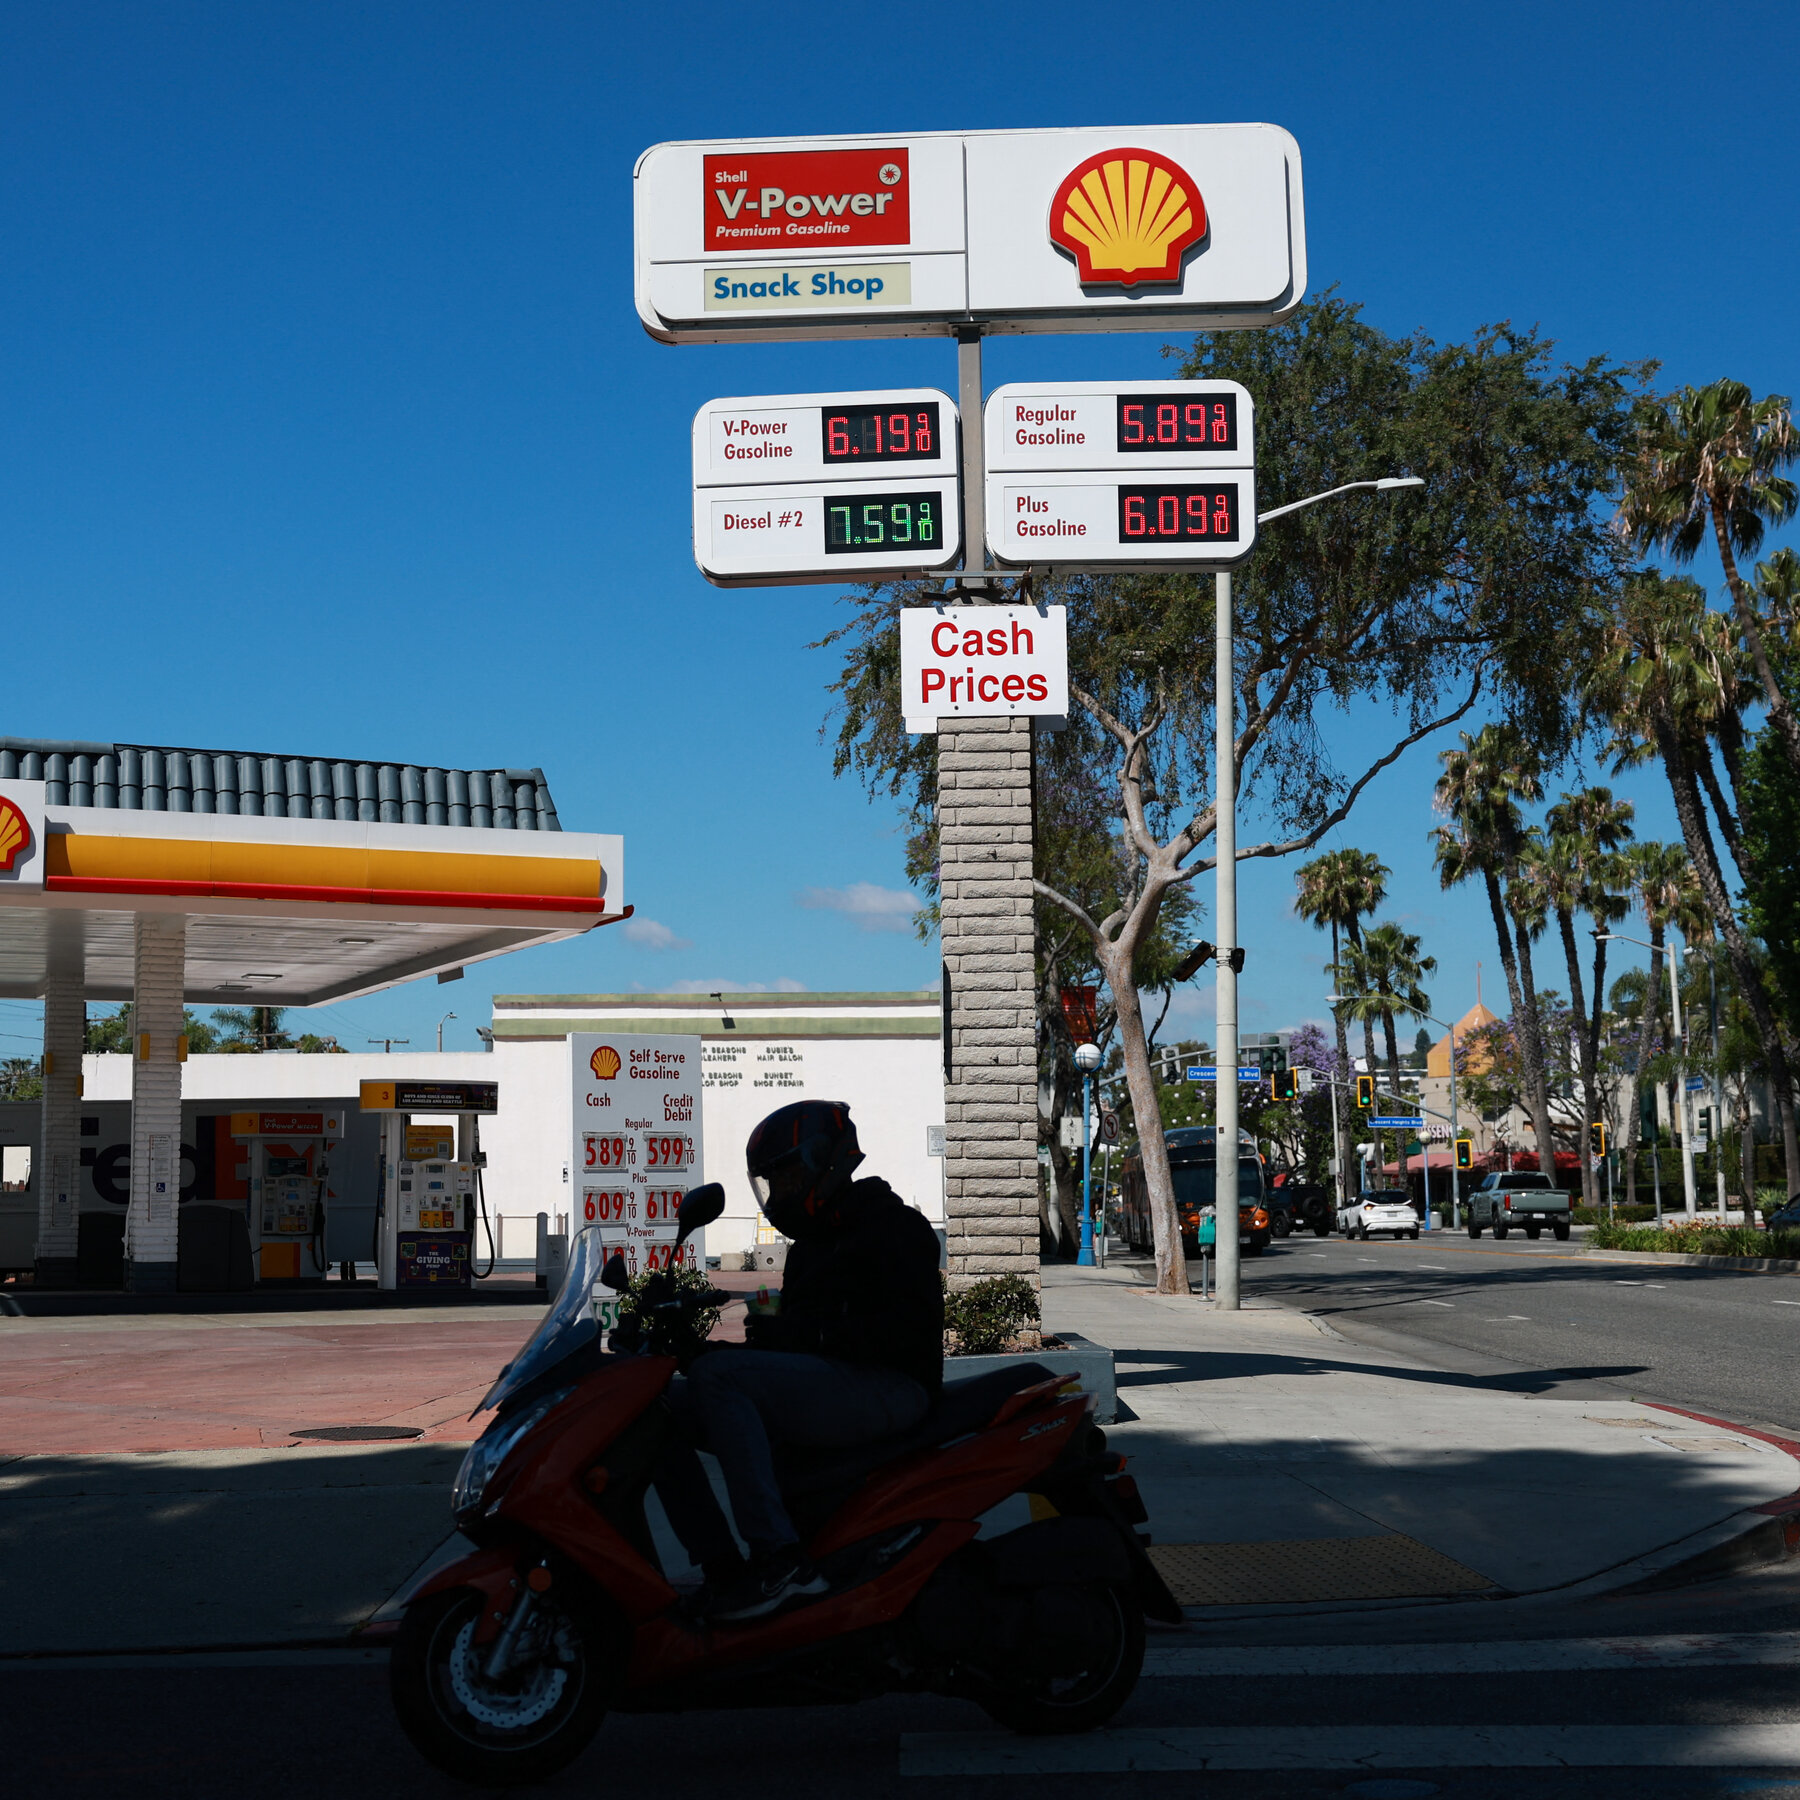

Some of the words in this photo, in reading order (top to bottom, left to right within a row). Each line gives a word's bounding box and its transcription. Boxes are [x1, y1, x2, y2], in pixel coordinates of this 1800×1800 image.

[715, 170, 748, 184] Shell
[715, 185, 893, 219] V-Power
[715, 224, 781, 238] Premium
[785, 220, 851, 236] Gasoline
[714, 272, 800, 300] Snack
[811, 270, 884, 300] Shop
[1016, 405, 1077, 426] Regular
[1123, 403, 1206, 444] 5.89
[723, 419, 788, 437] V-Power
[827, 414, 909, 456] 6.19
[1016, 428, 1086, 445] Gasoline
[724, 442, 792, 460] Gasoline
[1016, 496, 1050, 513] Plus
[723, 512, 772, 531] Diesel
[778, 510, 803, 527] #2
[831, 503, 911, 545] 7.59
[1124, 494, 1207, 536] 6.09
[1016, 520, 1087, 537] Gasoline
[931, 620, 1034, 658] Cash
[921, 666, 1049, 704] Prices
[629, 1049, 651, 1063] Self
[653, 1050, 686, 1064] Serve
[629, 1065, 680, 1080] Gasoline
[1244, 1070, 1259, 1078] Blvd
[777, 1080, 804, 1088] REPAIR
[382, 1091, 389, 1100] 3
[586, 1092, 611, 1107] Cash
[663, 1093, 694, 1108] Credit
[664, 1107, 692, 1122] Debit
[625, 1117, 653, 1131] Regular
[584, 1137, 624, 1166] 589
[647, 1137, 684, 1165] 599
[632, 1173, 648, 1183] Plus
[584, 1192, 624, 1221] 609
[646, 1190, 683, 1219] 619
[626, 1227, 655, 1237] V-Power
[416, 1256, 451, 1264] GIVING
